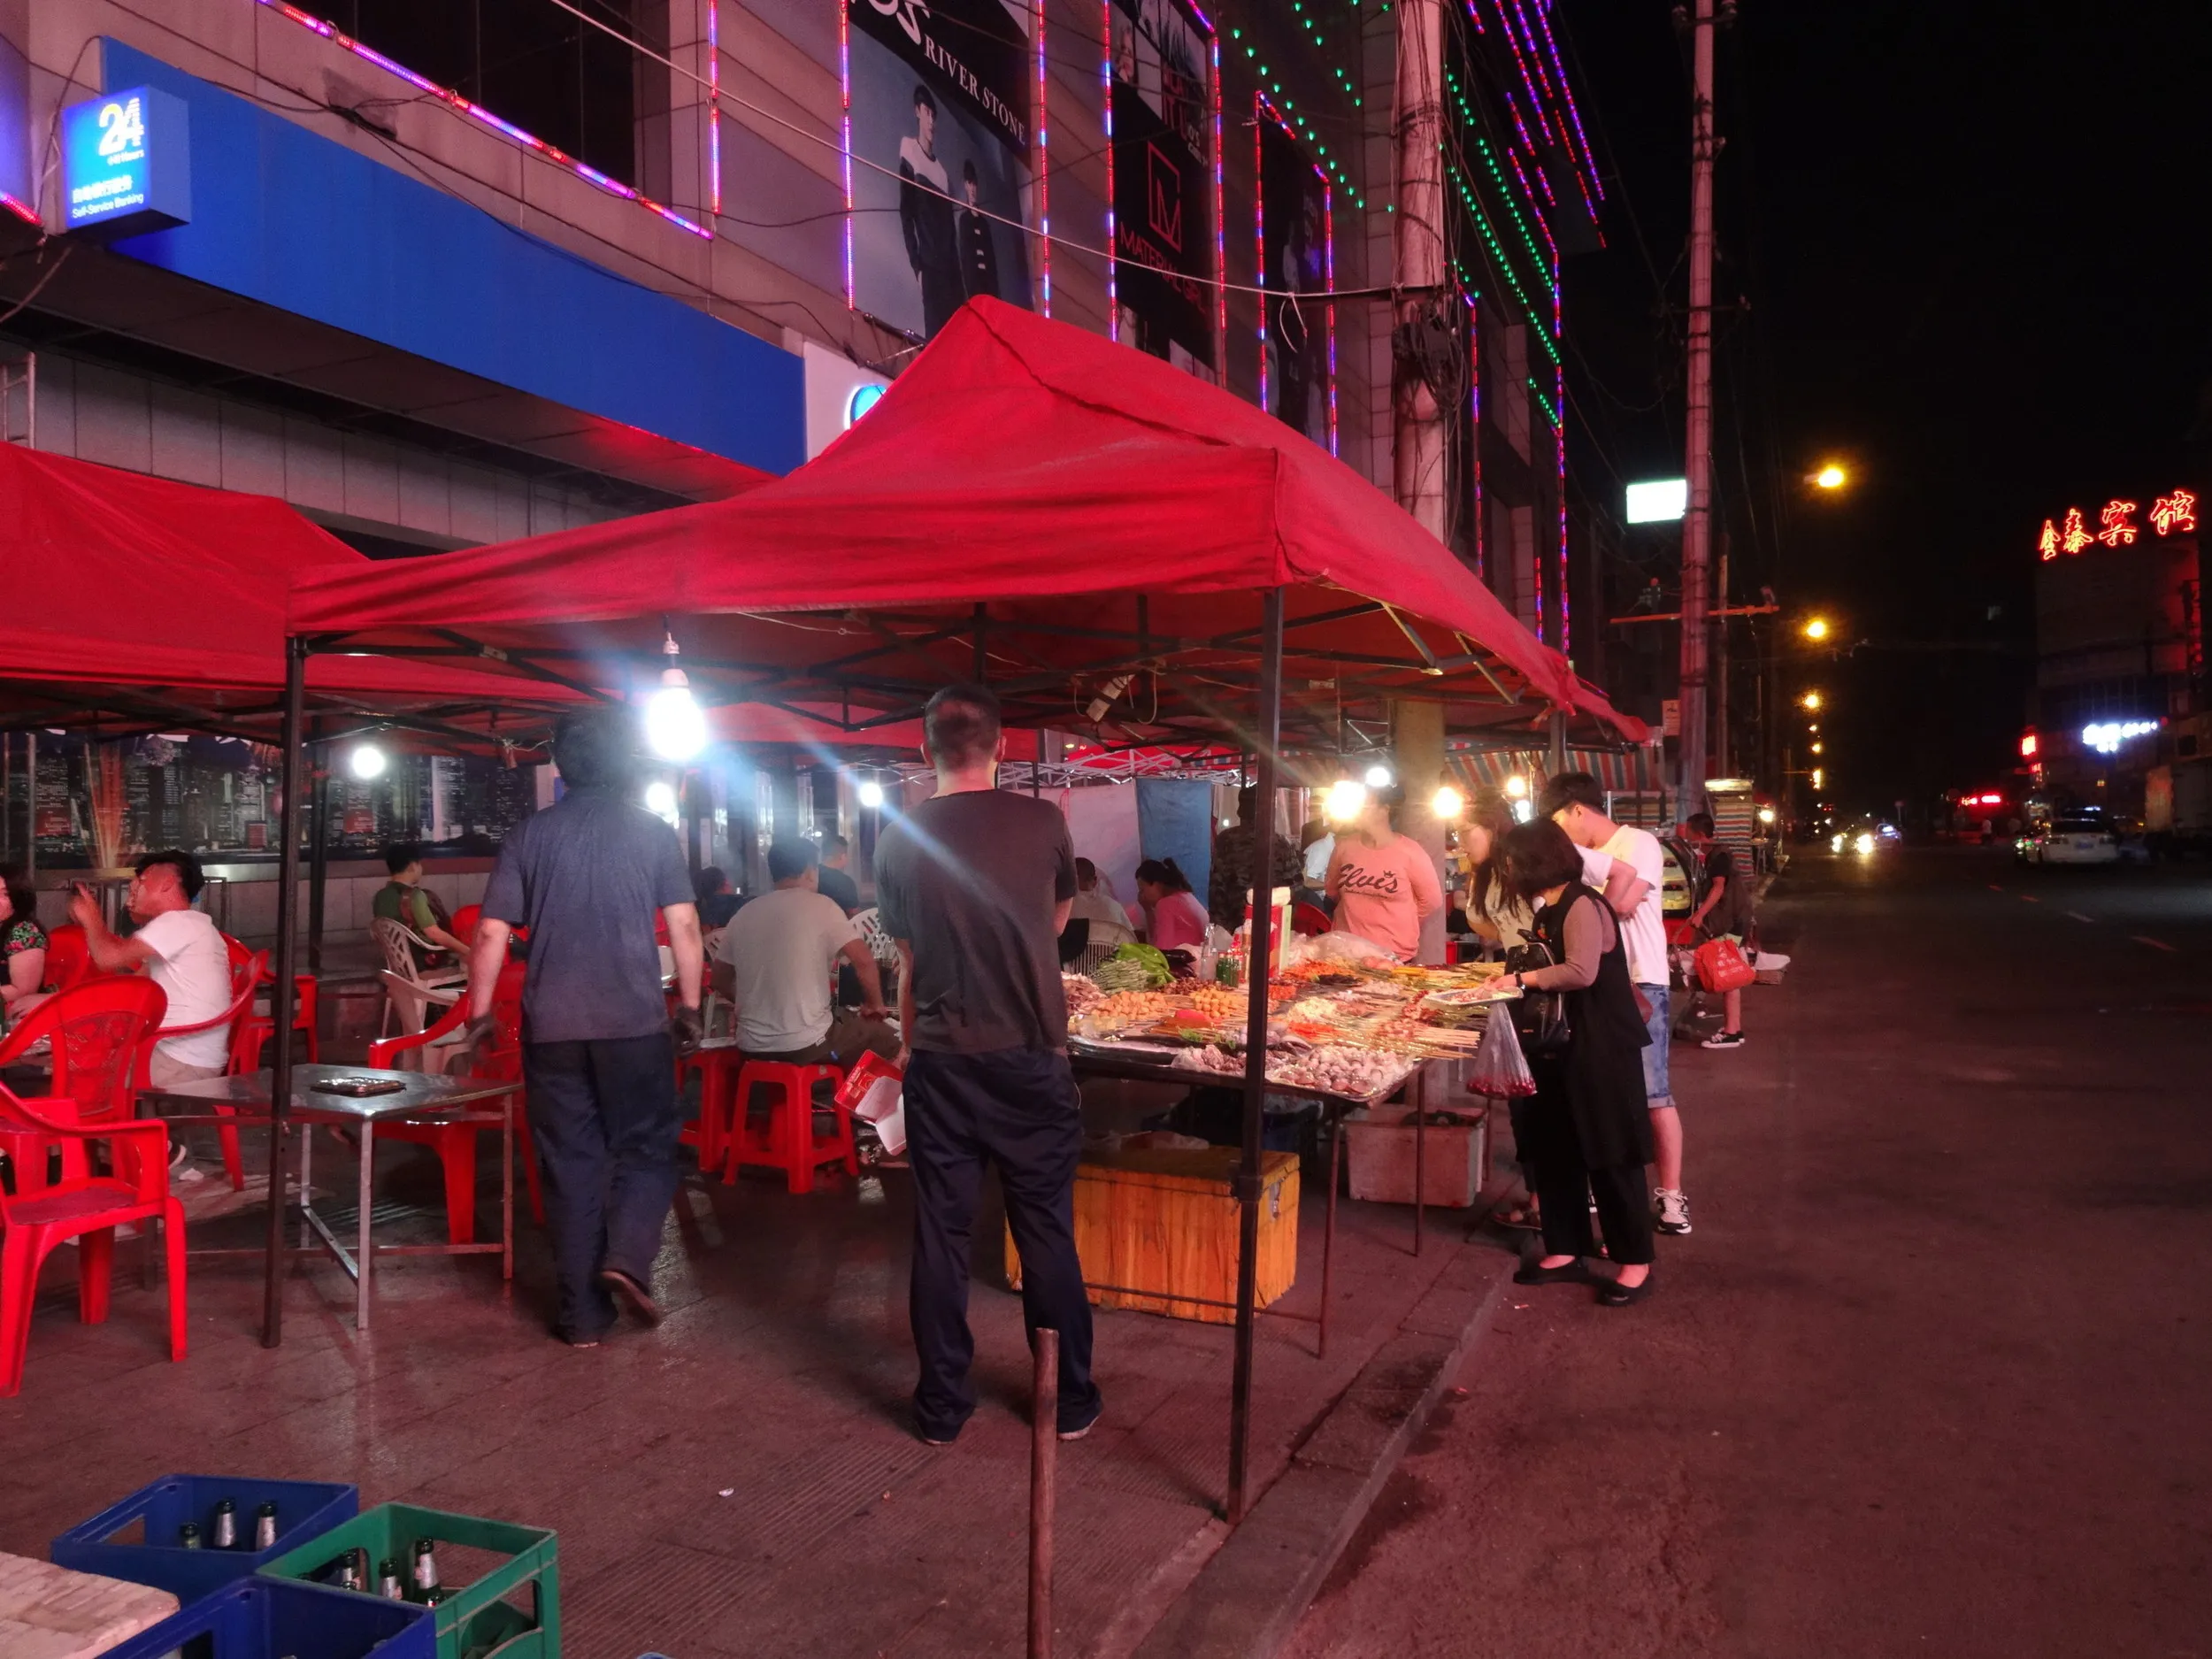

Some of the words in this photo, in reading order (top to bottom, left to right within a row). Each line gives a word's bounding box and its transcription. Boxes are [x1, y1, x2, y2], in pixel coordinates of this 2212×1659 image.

[925, 34, 979, 101] RIVER
[982, 86, 1026, 146] STONE
[98, 97, 144, 157] 24
[1120, 221, 1181, 293] MATERIAL
